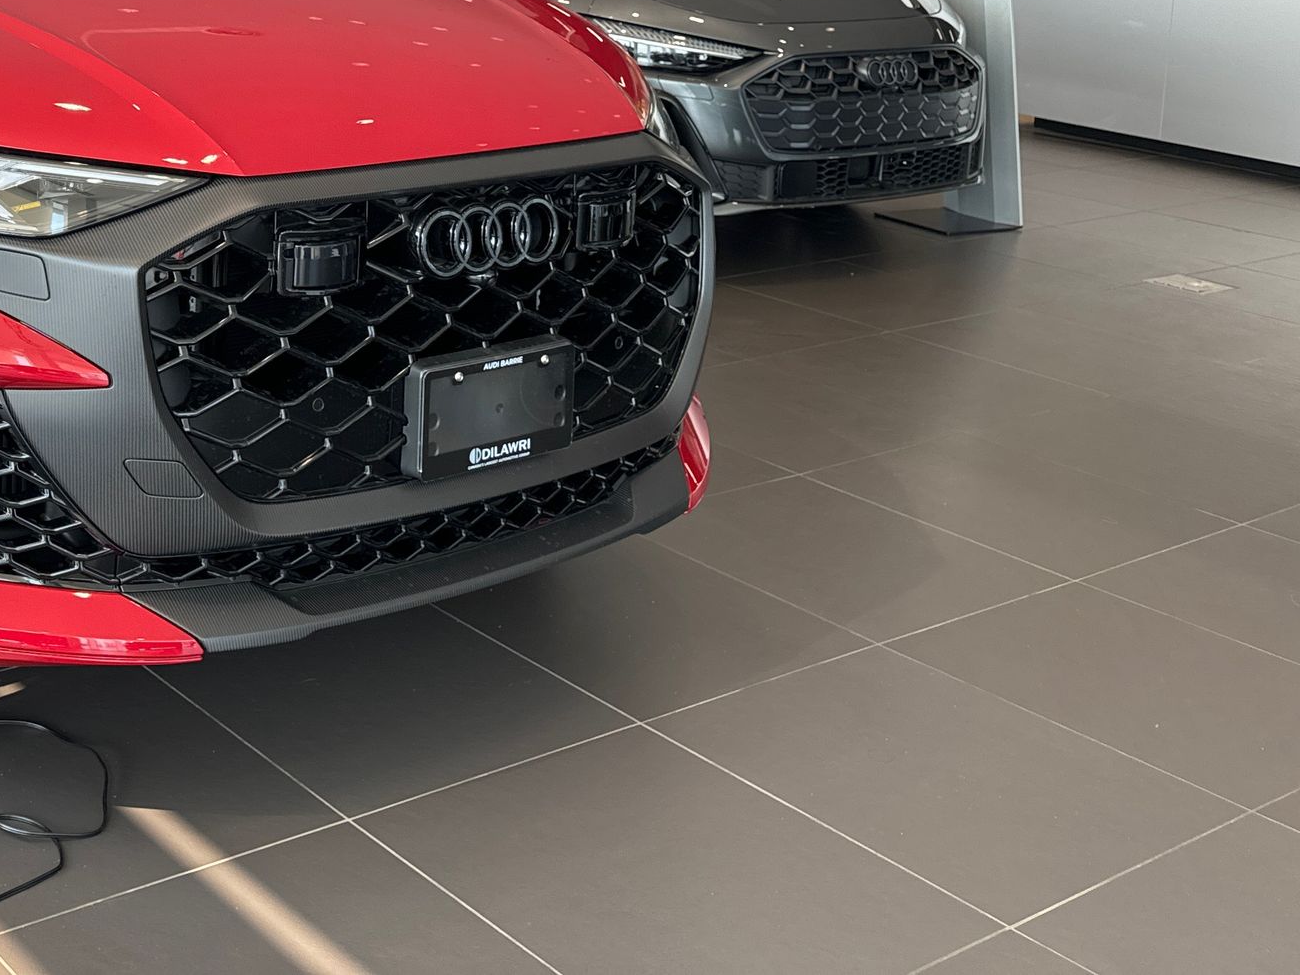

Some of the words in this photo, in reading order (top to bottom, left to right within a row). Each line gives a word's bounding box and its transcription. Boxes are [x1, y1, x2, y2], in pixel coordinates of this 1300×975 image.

[483, 361, 500, 371] AUDI
[500, 356, 524, 368] BARRIE
[481, 437, 531, 460] DILAWRI
